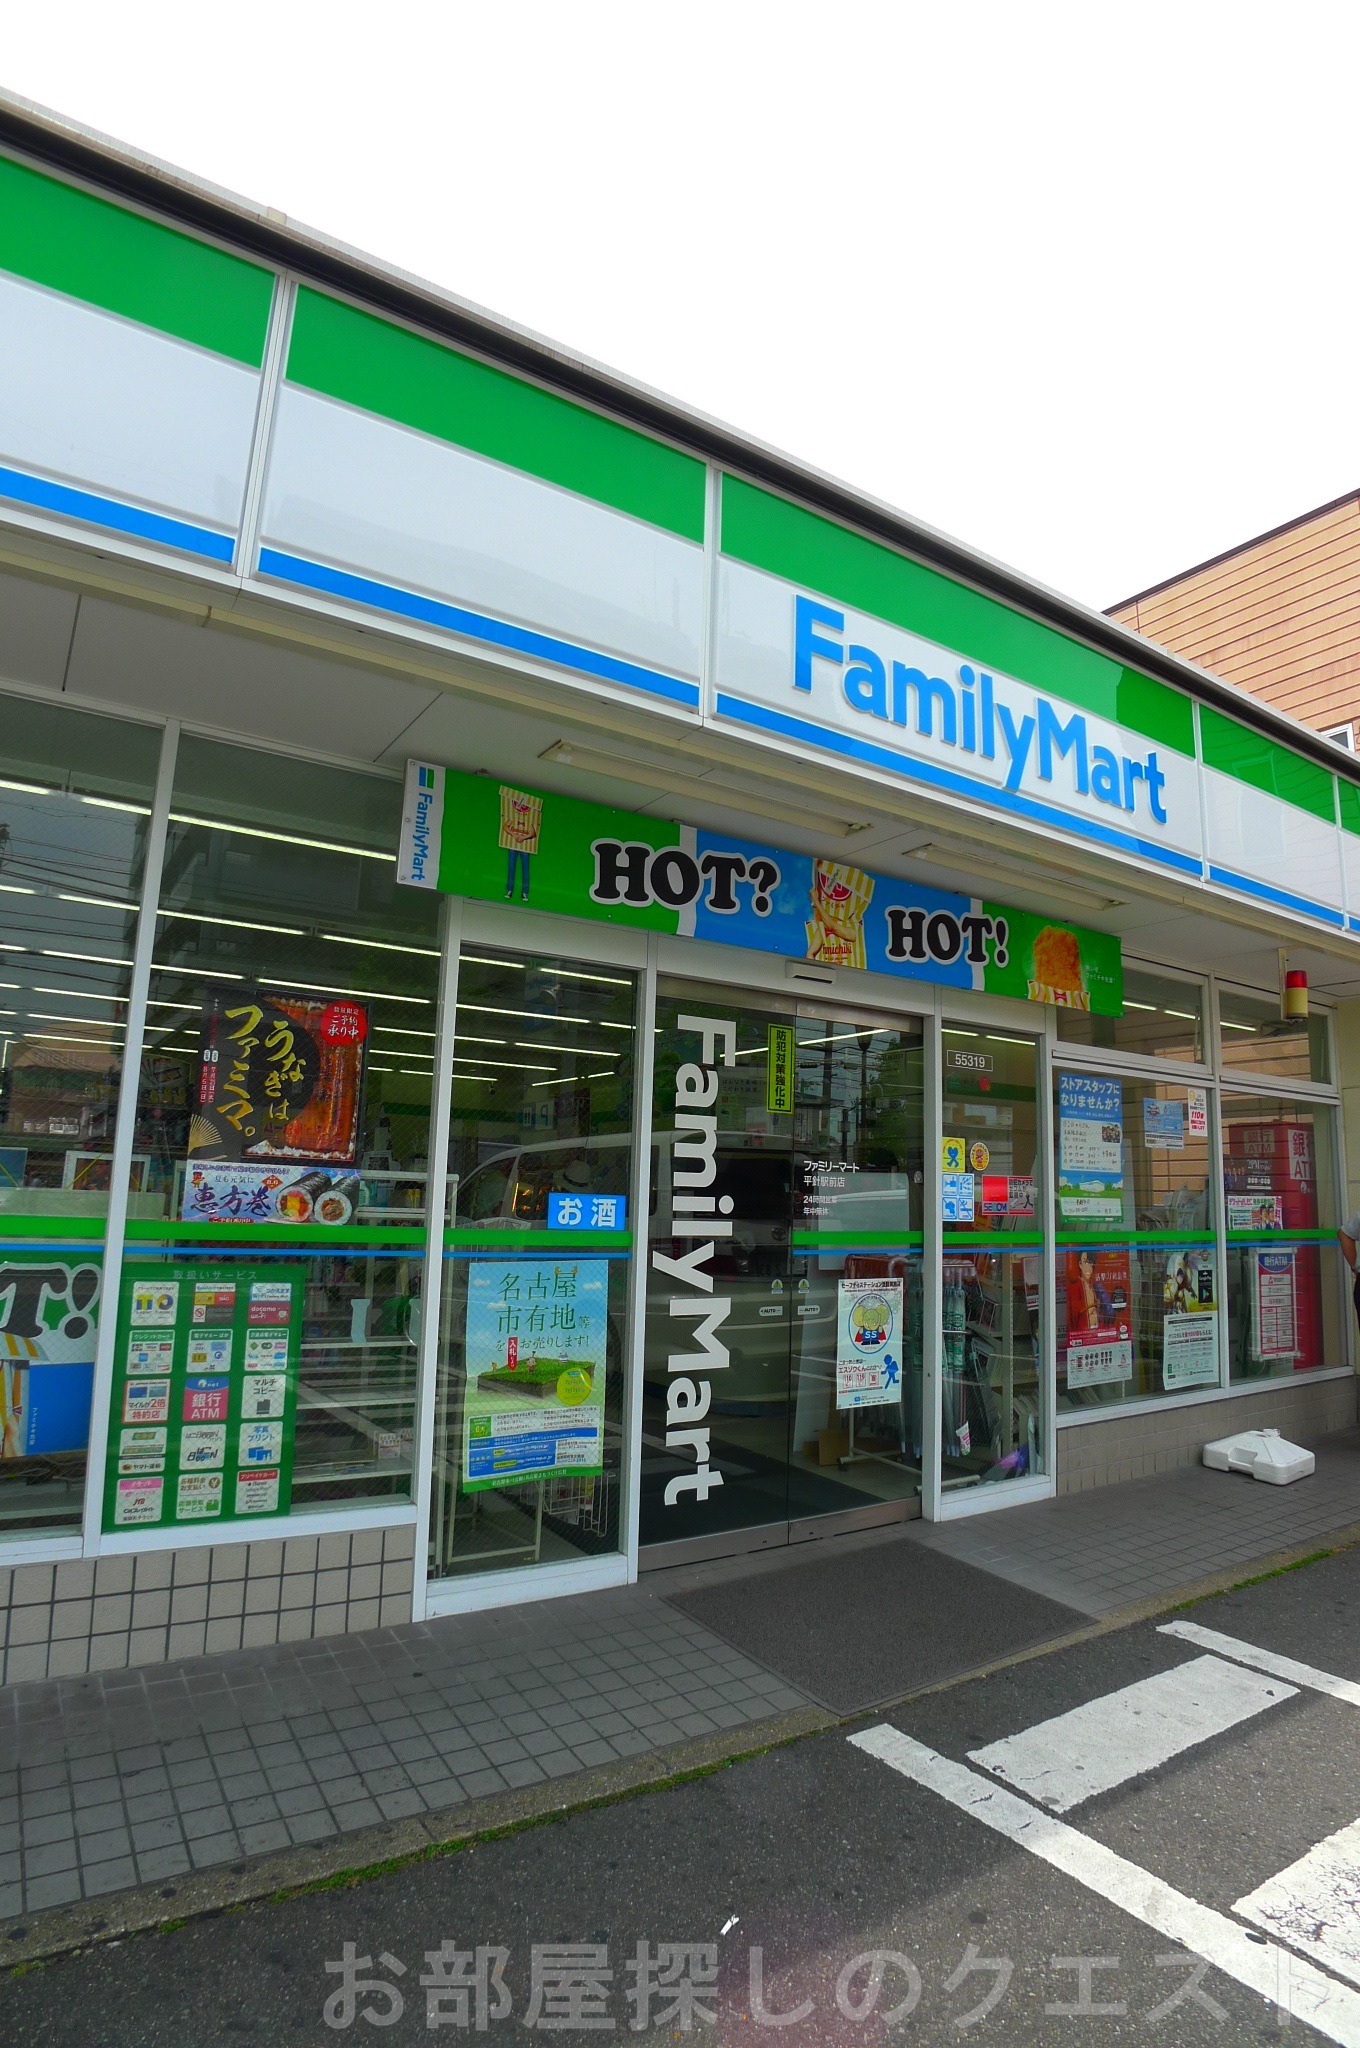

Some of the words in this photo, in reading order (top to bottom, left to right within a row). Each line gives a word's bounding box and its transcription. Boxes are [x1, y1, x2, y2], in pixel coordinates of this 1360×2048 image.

[793, 593, 1167, 825] FamilyMart
[411, 791, 434, 881] FamilyMart
[591, 840, 780, 915] HOT?
[887, 905, 1008, 967] HOT!
[331, 1015, 358, 1026] ご予約
[327, 1025, 359, 1039] 承り中
[775, 1028, 786, 1109] 防犯対策強化中
[955, 1053, 985, 1068] 55319
[264, 1020, 307, 1121] うなぎは
[1061, 1077, 1120, 1094] ストアスタッフに
[1060, 1093, 1120, 1111] なりませんか?
[803, 1160, 860, 1174] ファミリーマート
[803, 1175, 845, 1187] 平針駅前店
[190, 1183, 271, 1217] 恵方巻
[983, 1202, 1008, 1212] SECOM
[557, 1197, 617, 1228] お酒
[652, 1014, 737, 1506] FamilyMart
[173, 1270, 257, 1280] 取扱いサービス
[499, 1271, 577, 1302] 名古屋
[864, 1330, 878, 1339] SS
[192, 1393, 222, 1408] 銀行
[191, 1408, 220, 1419] ATM
[247, 1434, 275, 1442] プリント
